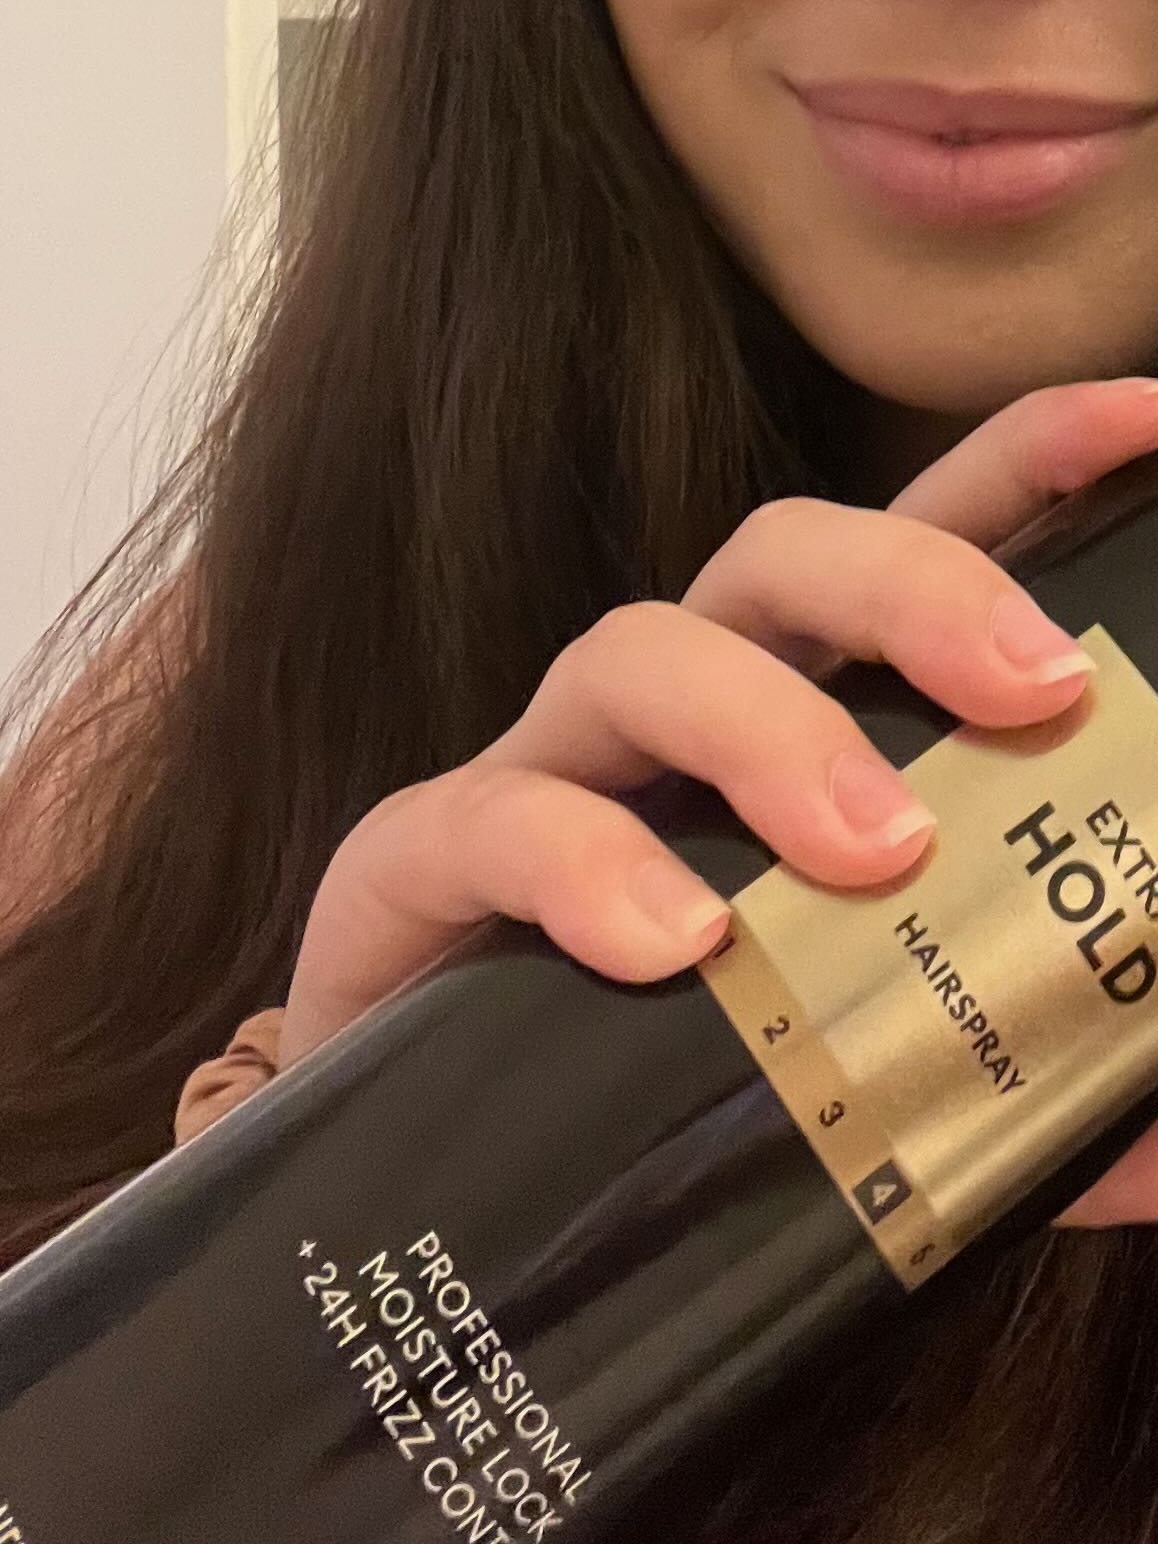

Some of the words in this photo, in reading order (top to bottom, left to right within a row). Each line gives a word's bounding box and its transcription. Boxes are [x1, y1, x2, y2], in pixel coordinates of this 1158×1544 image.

[1003, 801, 1158, 1005] HOLD
[762, 1014, 791, 1045] 2
[818, 1099, 845, 1128] 3
[894, 912, 1028, 1097] HAIRSPRAY
[303, 1261, 368, 1349] 24H
[350, 1343, 436, 1462] FRIZZ
[359, 1251, 498, 1456] MOISTURE
[481, 1447, 564, 1544] LOCK
[407, 1230, 593, 1507] PROFESSIONAL
